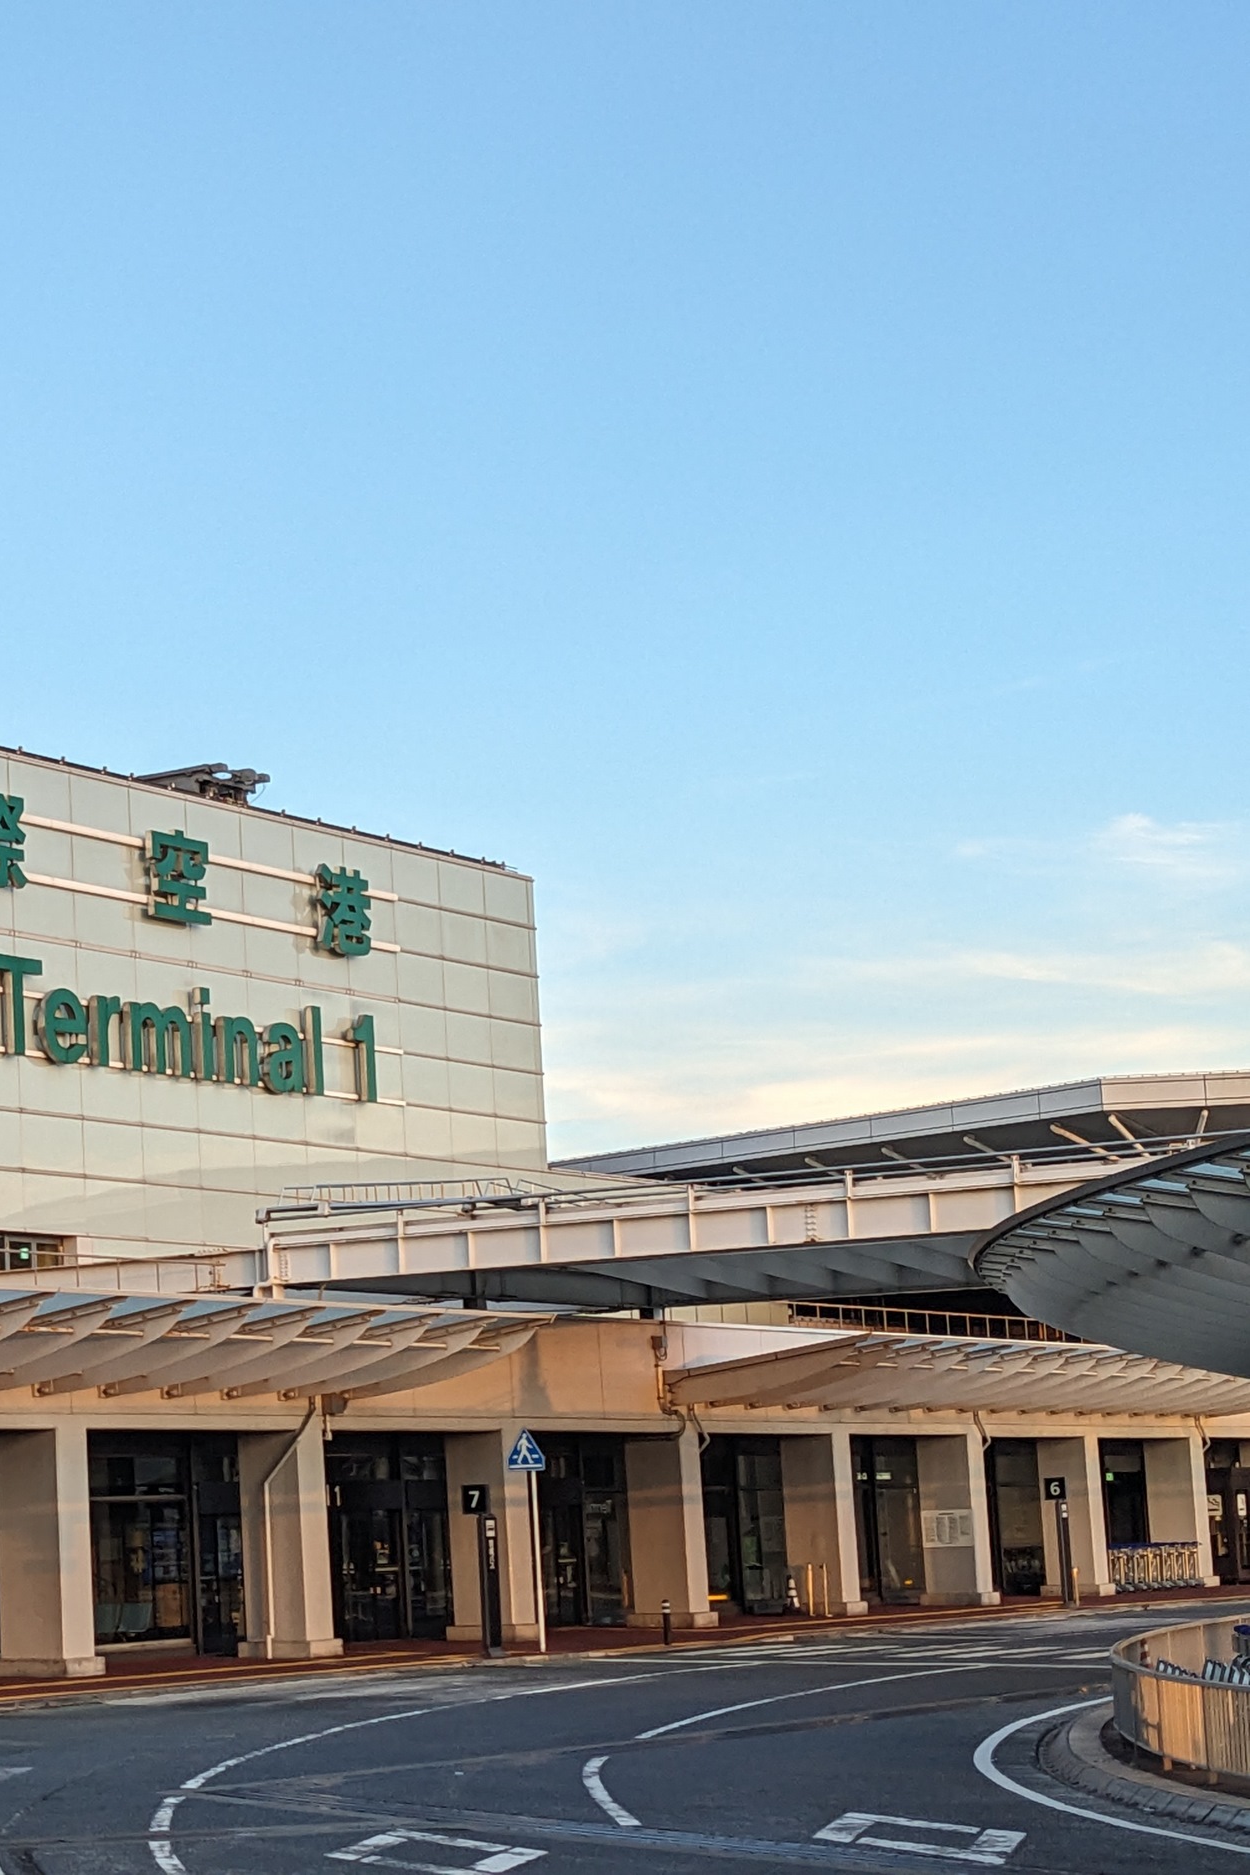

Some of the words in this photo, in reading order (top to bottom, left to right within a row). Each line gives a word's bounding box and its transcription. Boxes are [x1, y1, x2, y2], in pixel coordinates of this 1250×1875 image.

[346, 1014, 378, 1103] 1
[1050, 1481, 1061, 1496] 6
[468, 1490, 480, 1508] 7
